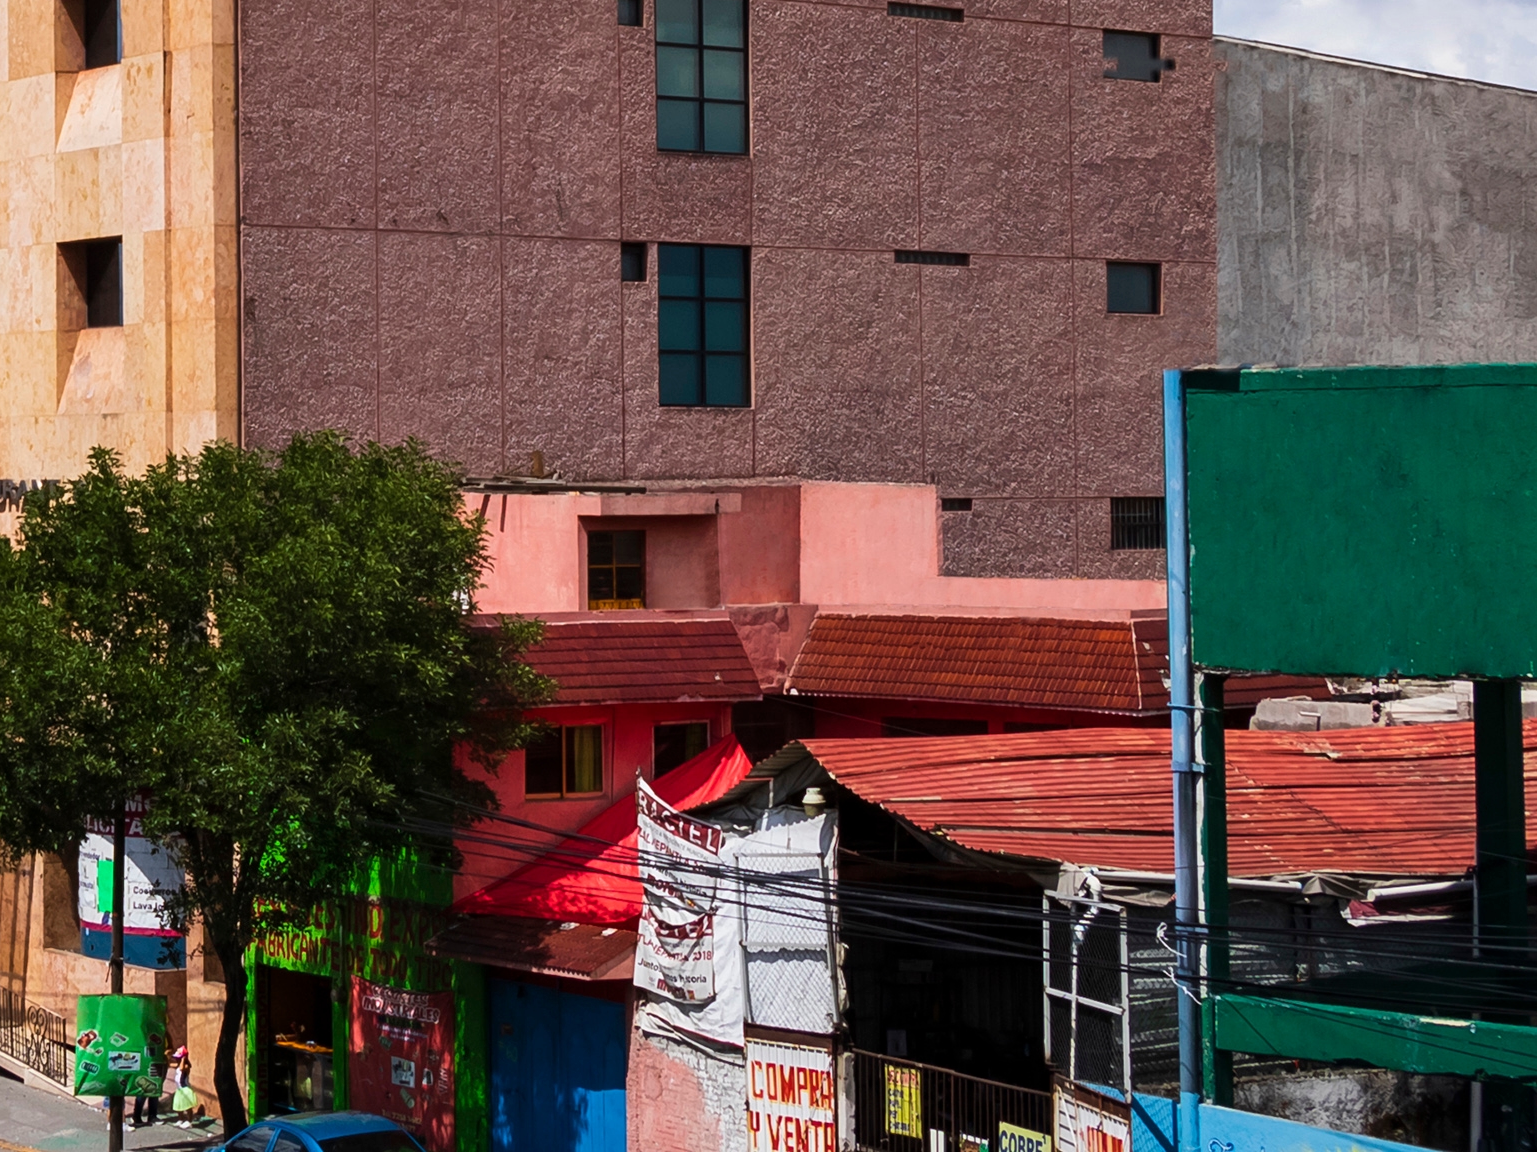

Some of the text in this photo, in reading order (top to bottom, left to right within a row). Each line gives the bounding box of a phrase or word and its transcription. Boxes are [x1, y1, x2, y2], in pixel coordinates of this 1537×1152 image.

[638, 789, 720, 854] RACIEL
[751, 1060, 833, 1110] COMPRA
[749, 1110, 835, 1152] Y VENTA
